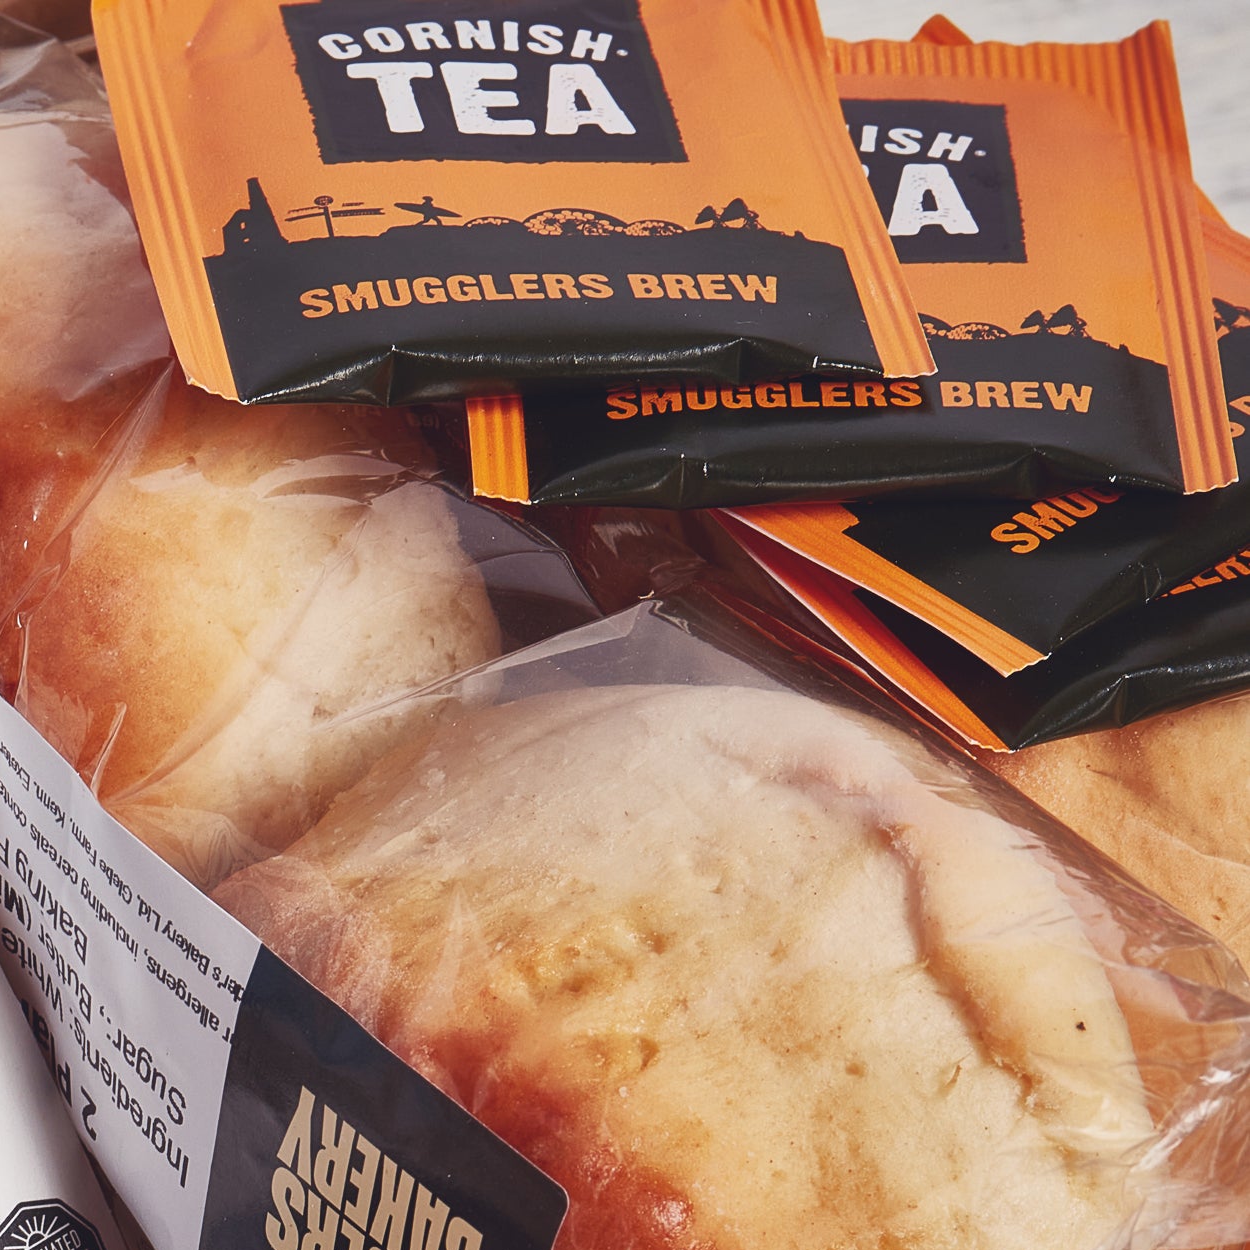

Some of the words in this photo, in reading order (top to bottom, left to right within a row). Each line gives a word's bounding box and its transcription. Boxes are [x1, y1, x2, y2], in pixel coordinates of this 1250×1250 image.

[318, 19, 613, 62] CORNISH
[346, 61, 637, 136] TEA
[299, 273, 615, 319] SMUGGLERS
[626, 273, 778, 304] BREW
[606, 379, 923, 421] SMUGGLERS
[939, 380, 1094, 414] BREW
[29, 823, 79, 886] cereals
[99, 859, 134, 905] Glebe
[14, 847, 89, 966] Baking
[79, 877, 140, 962] including
[1, 926, 65, 1023] White
[37, 923, 93, 1025] Butter
[161, 919, 211, 976] Bakery
[143, 947, 221, 1032] allergens,
[211, 965, 246, 1004] der's
